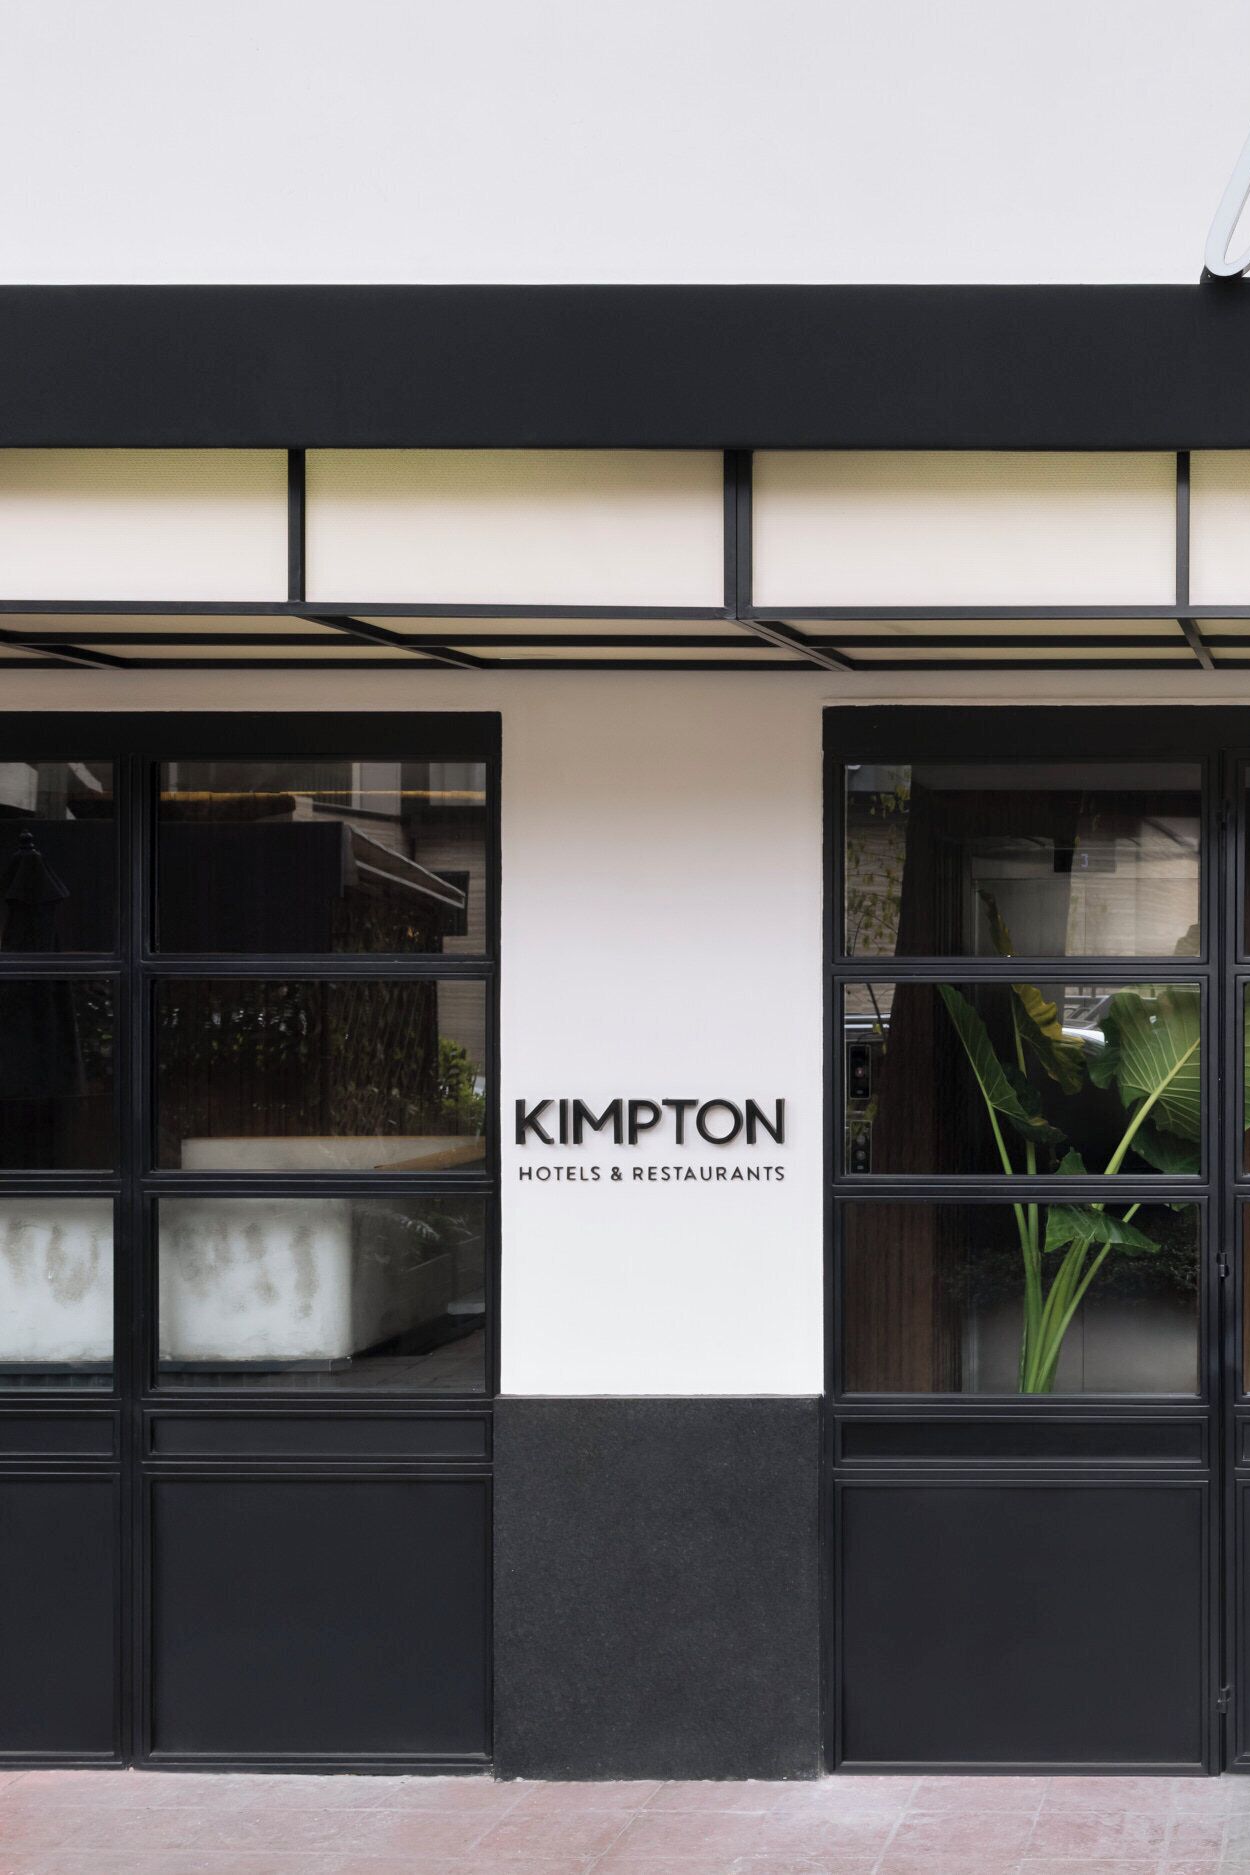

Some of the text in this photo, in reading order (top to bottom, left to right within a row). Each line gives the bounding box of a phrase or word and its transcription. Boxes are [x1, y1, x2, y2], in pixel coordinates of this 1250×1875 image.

[515, 1098, 785, 1145] KIMPTON
[519, 1166, 785, 1181] HOTELS & RESTAURANTS
